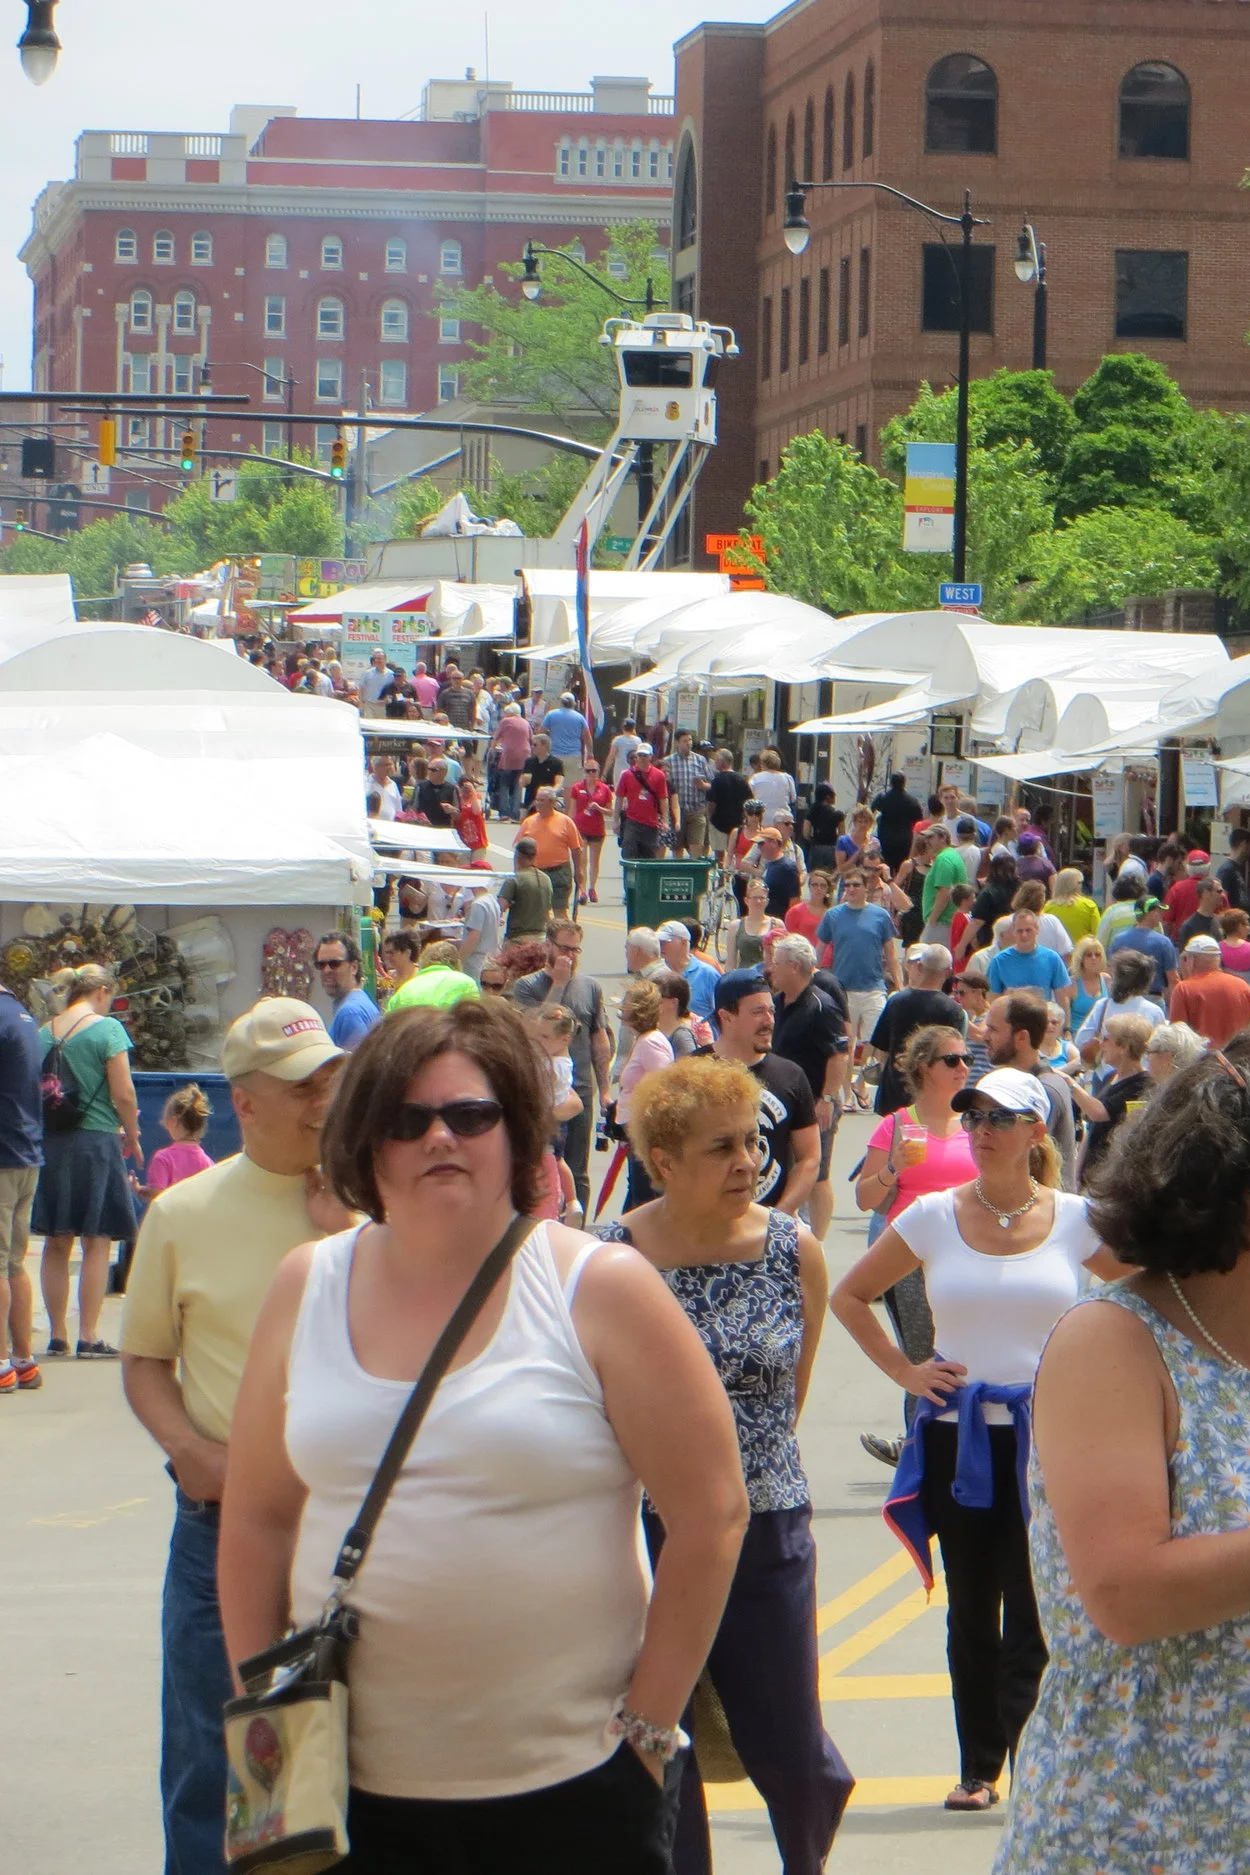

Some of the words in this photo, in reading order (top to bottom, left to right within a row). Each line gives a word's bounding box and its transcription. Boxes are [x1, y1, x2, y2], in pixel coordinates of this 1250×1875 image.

[717, 540, 739, 549] BIKE
[945, 586, 975, 600] WEST
[348, 615, 381, 633] arts
[392, 615, 426, 633] arts
[347, 633, 380, 641] FESTIVAL
[761, 1092, 784, 1118] PARTY
